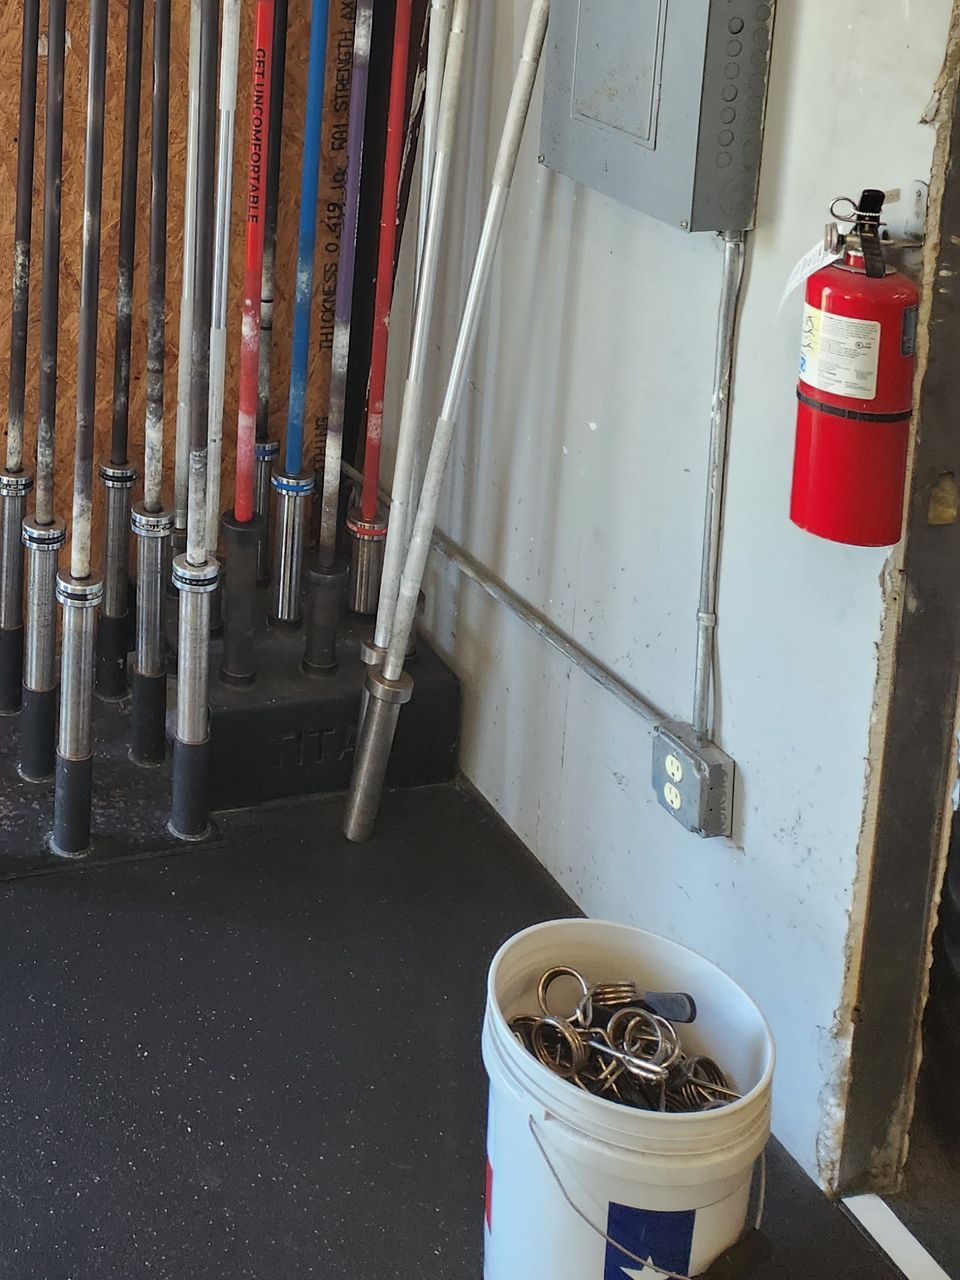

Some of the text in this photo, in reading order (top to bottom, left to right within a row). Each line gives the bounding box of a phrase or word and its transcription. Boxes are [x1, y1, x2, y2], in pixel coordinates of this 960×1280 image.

[247, 48, 266, 224] GET UNCOMFORTABLE
[319, 263, 338, 351] THICKNESS
[334, 30, 354, 114] STRENGTH
